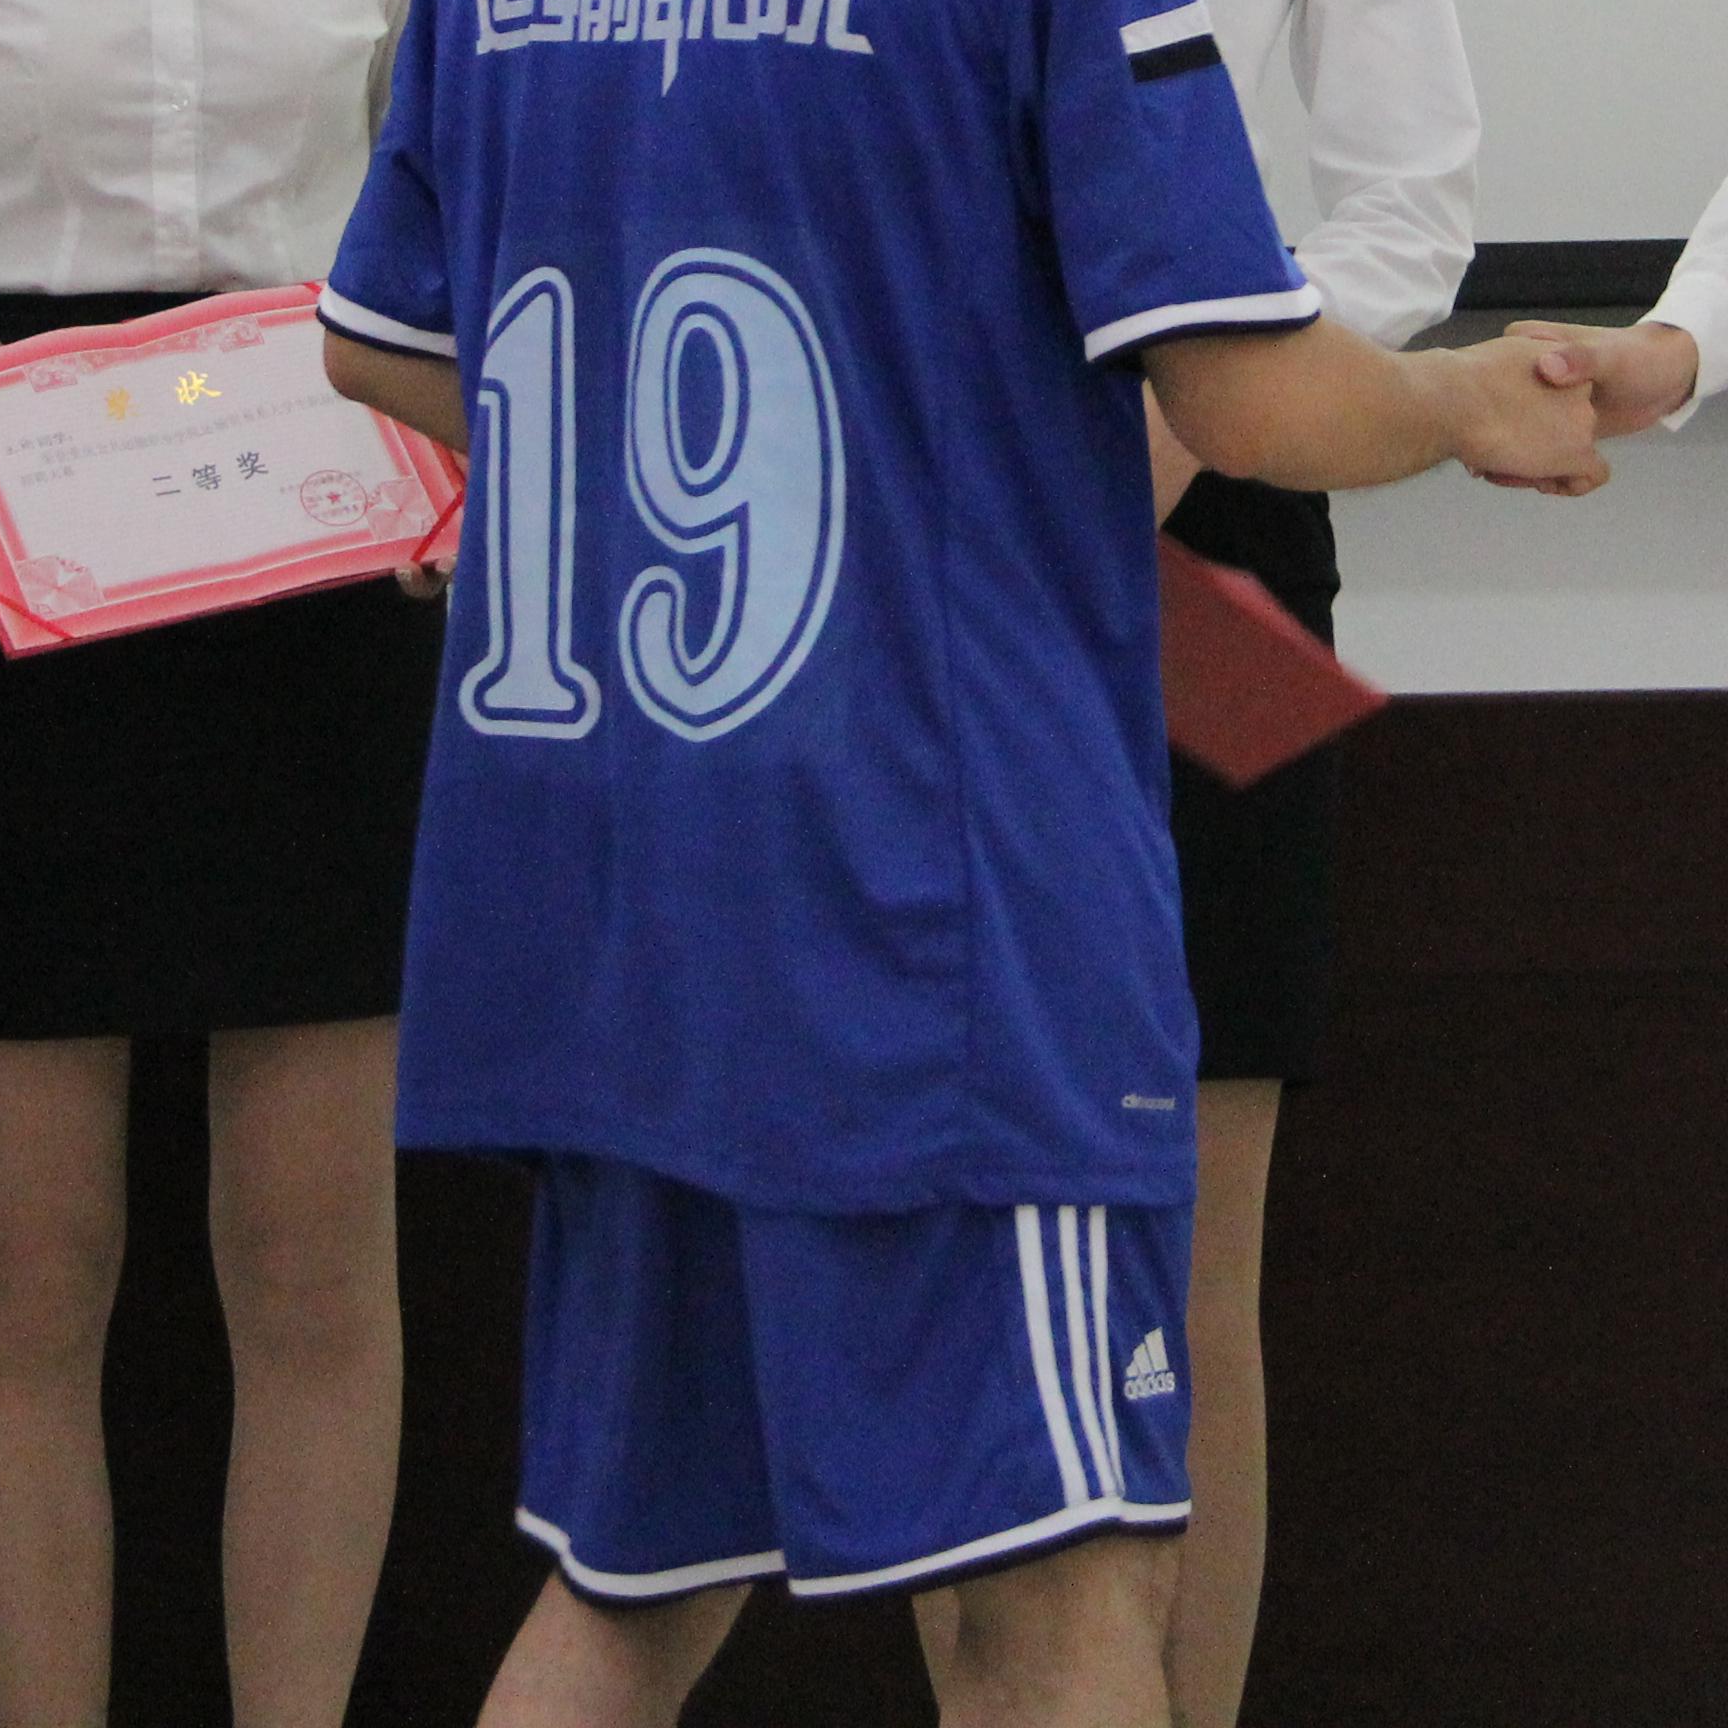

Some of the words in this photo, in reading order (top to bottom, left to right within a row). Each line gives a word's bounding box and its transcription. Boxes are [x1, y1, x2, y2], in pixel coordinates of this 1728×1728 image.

[152, 451, 269, 497] 二等奖
[458, 246, 846, 742] 19
[1123, 1371, 1176, 1401] adidas
